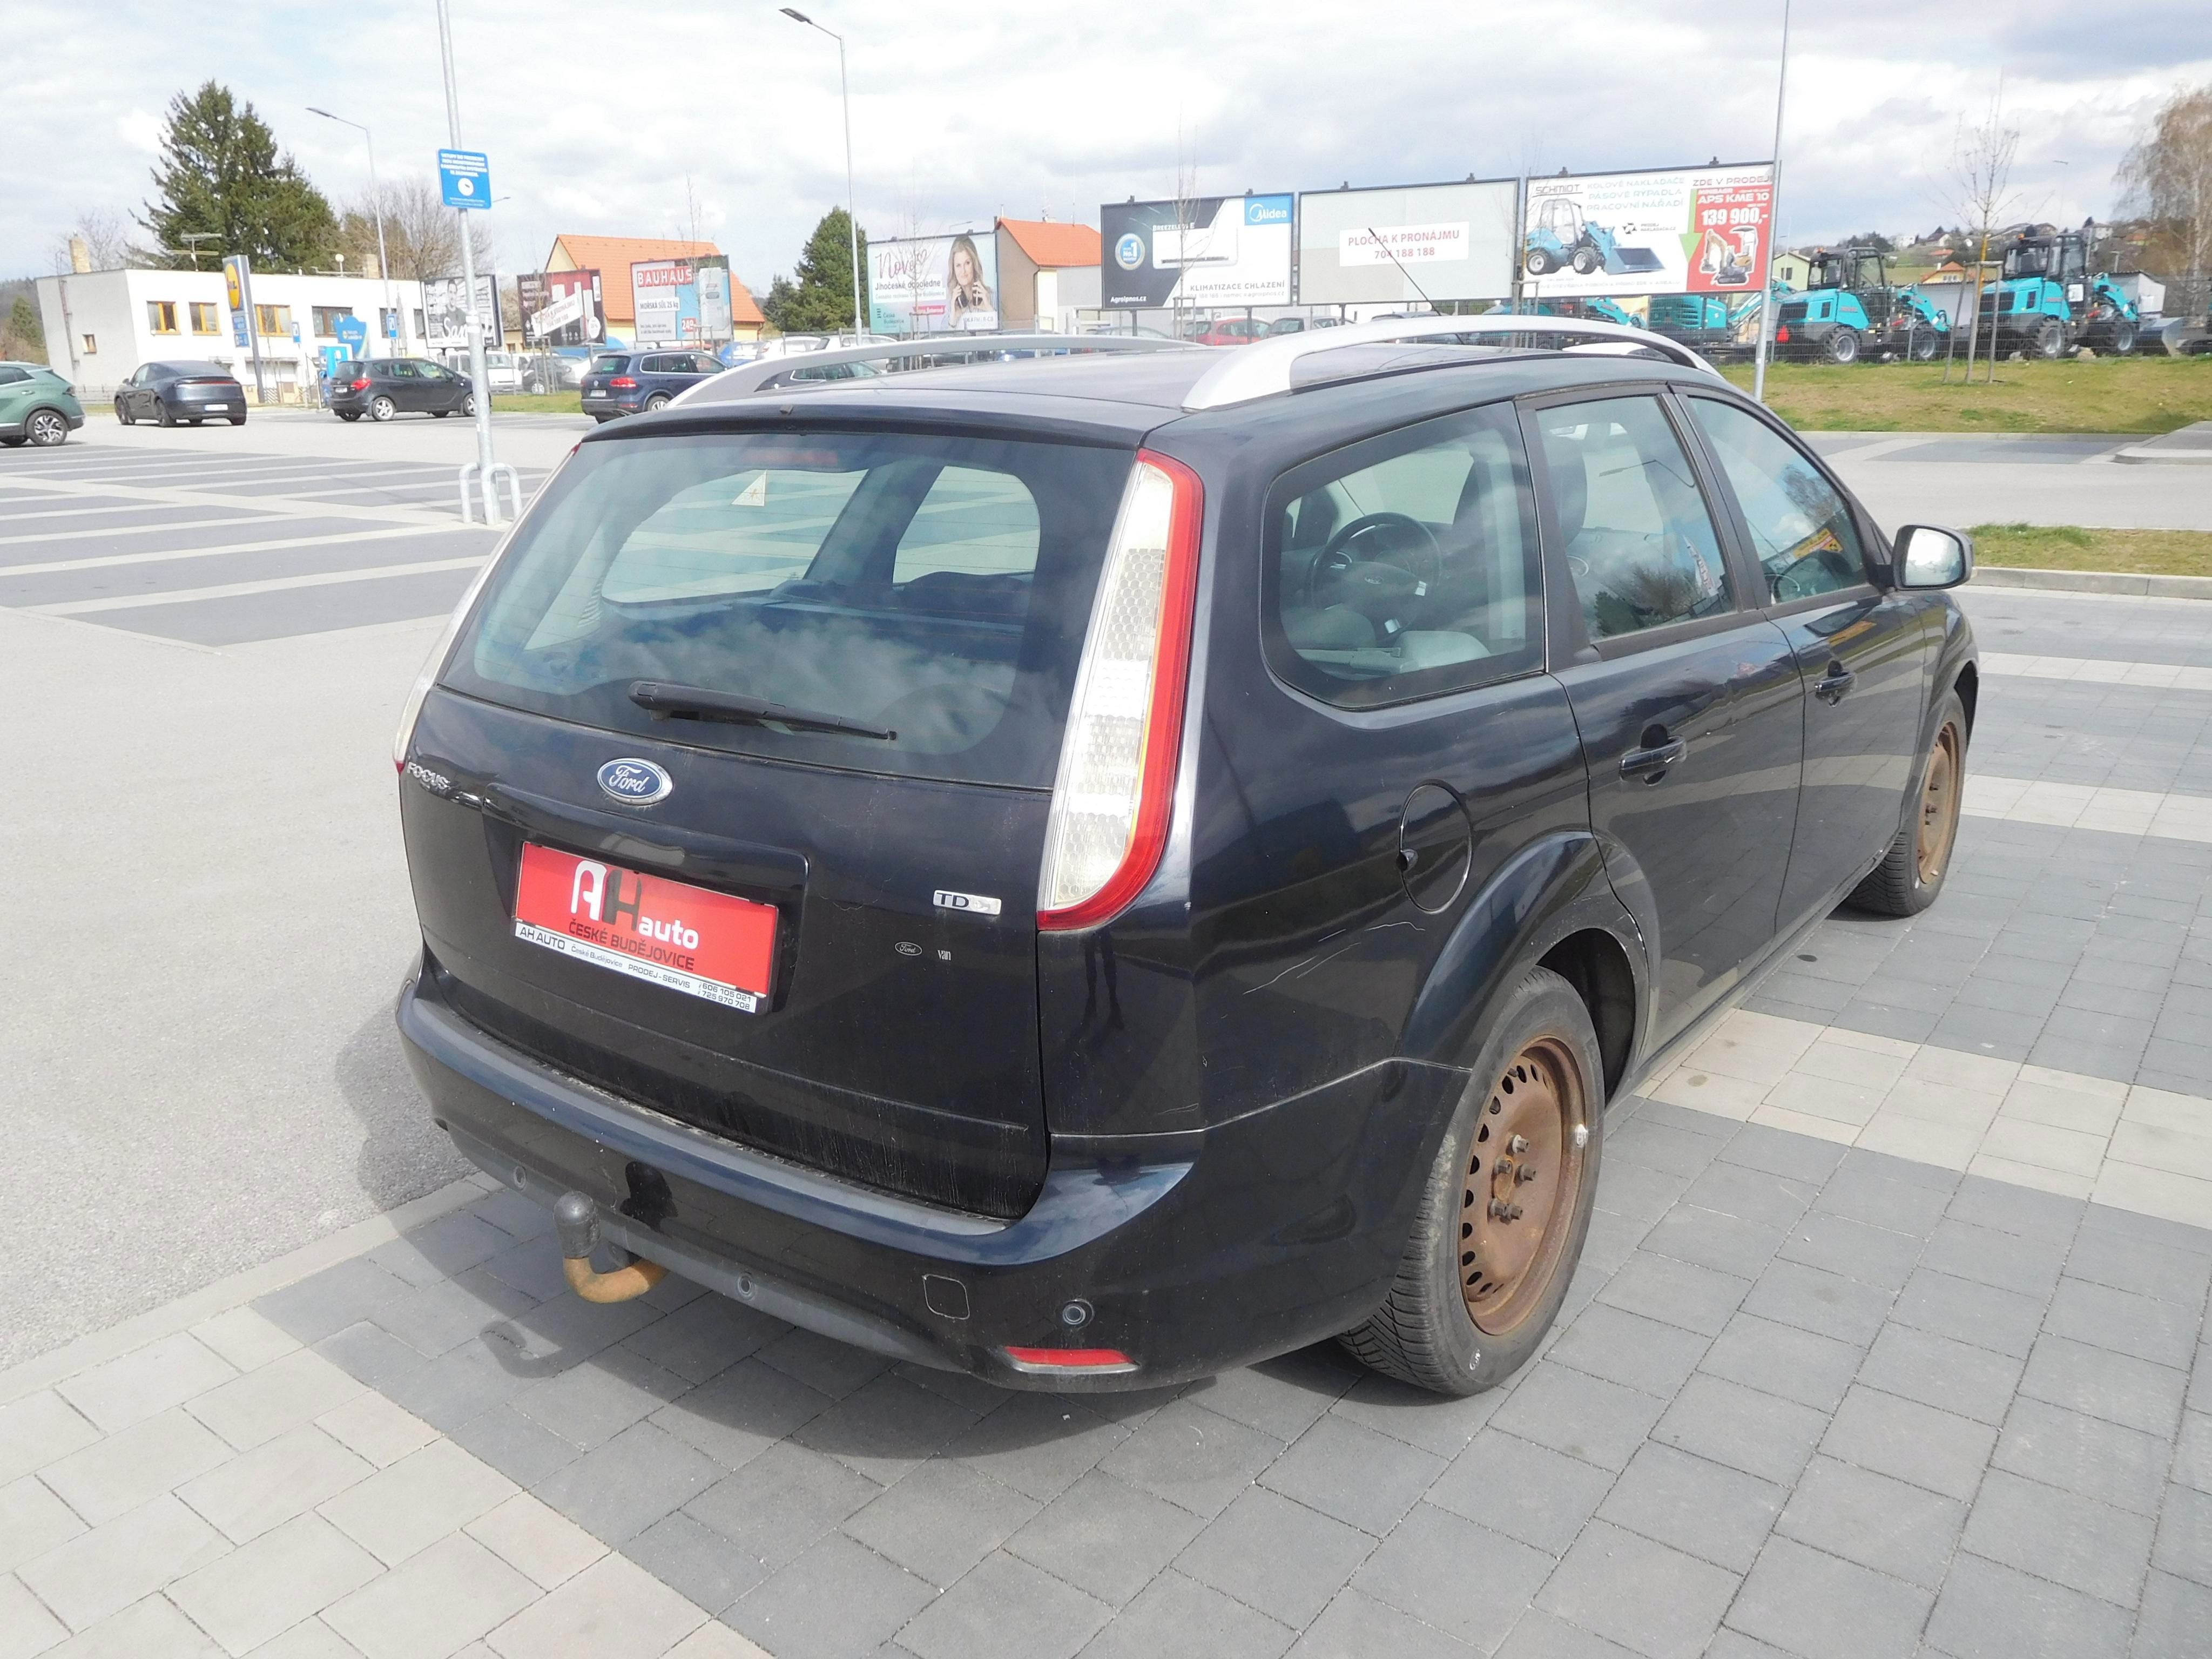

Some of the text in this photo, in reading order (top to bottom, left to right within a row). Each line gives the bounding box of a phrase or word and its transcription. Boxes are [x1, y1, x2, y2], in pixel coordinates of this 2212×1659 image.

[1697, 192, 1770, 204] APS KME 10
[1251, 205, 1287, 221] Midea
[1701, 207, 1769, 225] 139 900,-
[1348, 230, 1459, 246] PLOCHA K PRONÁJMU
[1374, 247, 1435, 259] 704 188 188
[638, 269, 692, 286] BAUHAUS
[875, 281, 906, 290] Jihočeské
[1190, 280, 1285, 291] KLIMATIZACE CHLAZENÍ
[407, 761, 450, 790] FOCUS
[609, 765, 650, 792] Ford
[520, 927, 534, 940] AH
[536, 930, 565, 950] AUTO
[571, 943, 589, 958] České
[590, 952, 623, 968] Budějovice
[569, 918, 694, 970] ČESKÉ BUDĚJOVICE
[937, 949, 952, 961] van
[702, 990, 750, 1010] 725 970 708
[703, 983, 751, 1003] 606 105 021
